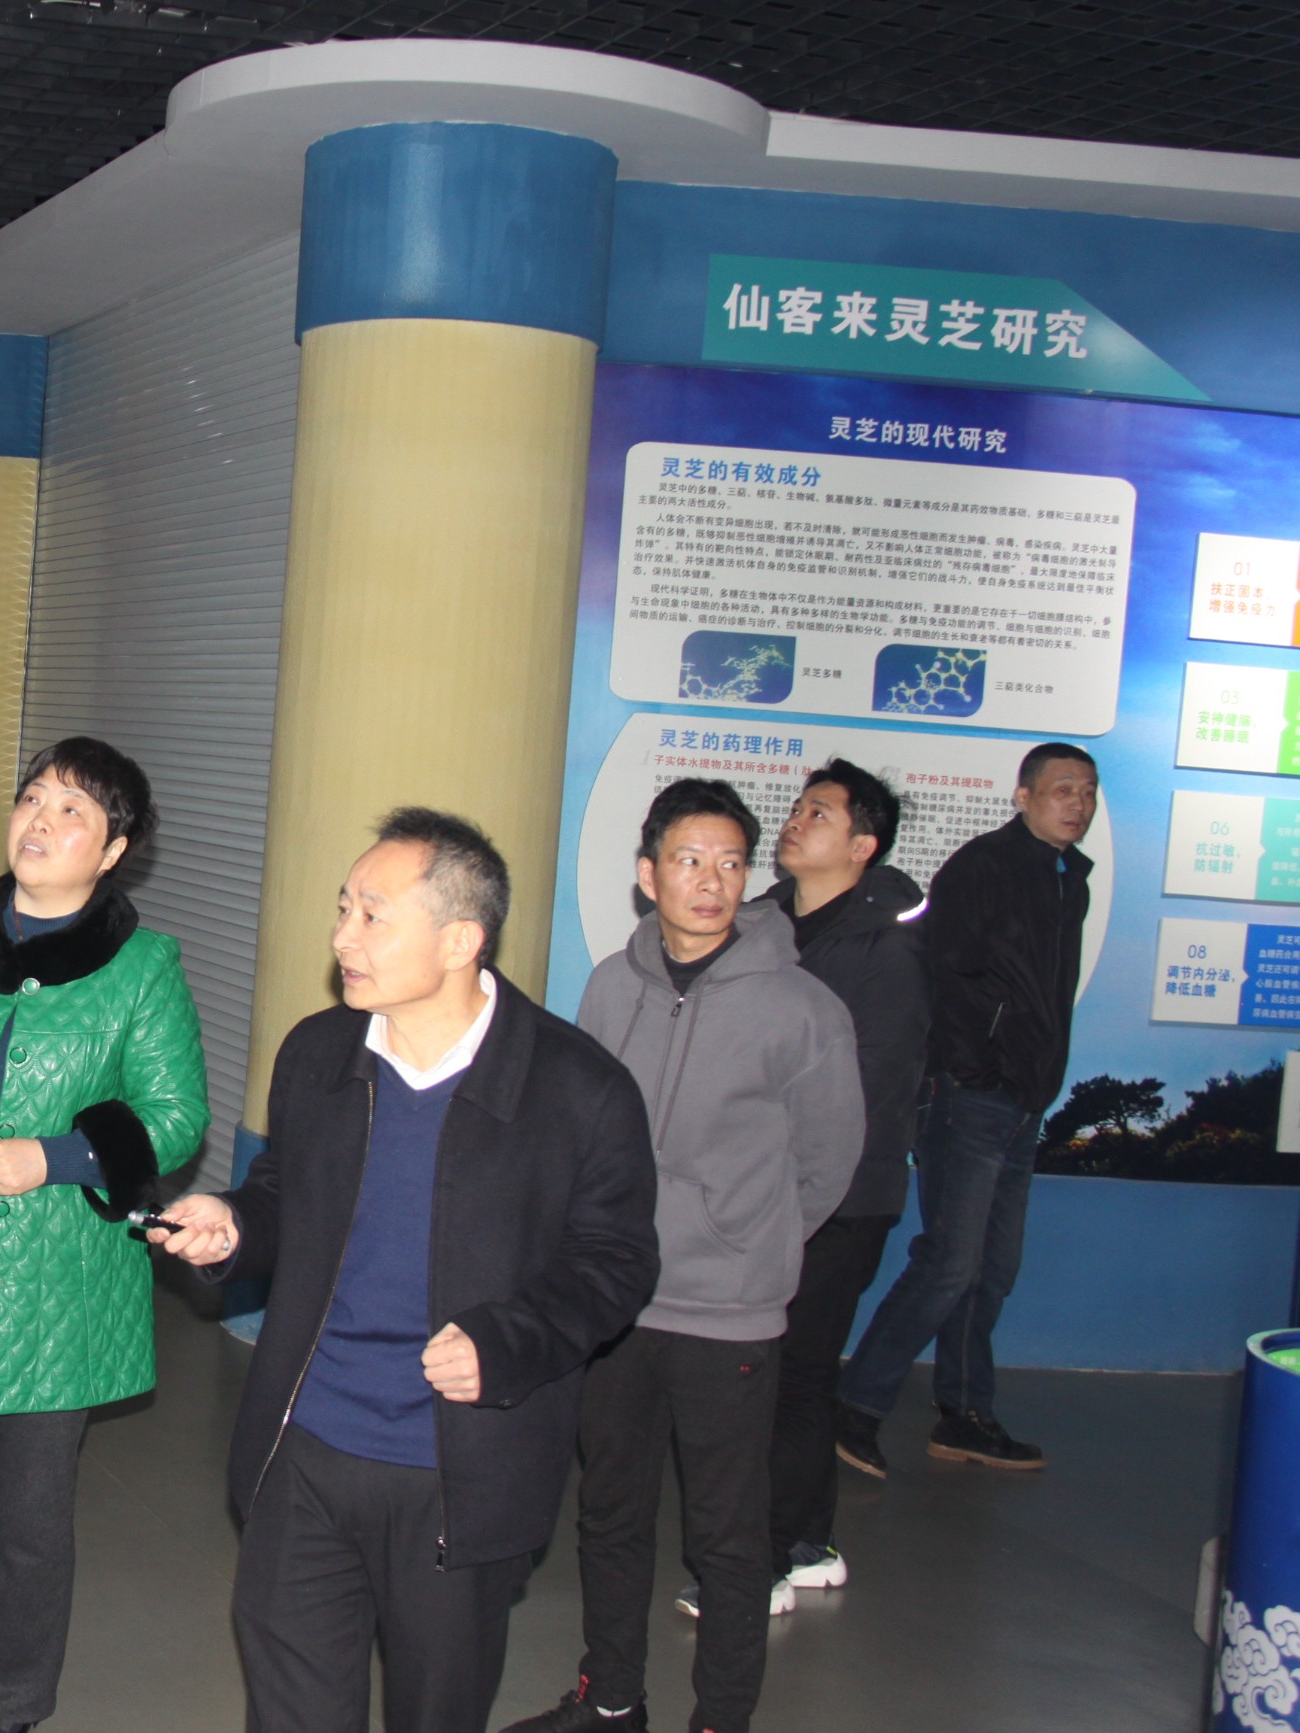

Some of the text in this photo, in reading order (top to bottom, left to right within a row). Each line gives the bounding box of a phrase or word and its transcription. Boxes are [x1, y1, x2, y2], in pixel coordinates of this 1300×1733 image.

[723, 283, 1089, 359] 仙客来灵芝研究
[829, 416, 1008, 454] 灵芝的现代研究
[660, 456, 822, 488] 灵芝的有效成分
[638, 494, 732, 512] 主要的两大活性成分。
[632, 566, 717, 582] 态，保持肌体健康。
[1233, 561, 1251, 577] 01
[1208, 598, 1276, 617] 增强免疫力
[801, 667, 842, 680] 灵芝多糖
[994, 680, 1055, 695] 三萜类化合物
[1220, 690, 1240, 704] 03
[658, 727, 804, 757] 灵芝的药理作用
[1195, 727, 1250, 744] 改善睡眠
[653, 754, 825, 777] 子实体水提物及其所含多糖（肽
[906, 773, 995, 790] 孢子粉及其提取物
[1210, 820, 1230, 836] 06
[896, 857, 945, 868] 孢子粉中提
[1194, 858, 1234, 874] 防辐射
[1187, 943, 1207, 959] 08
[1166, 964, 1236, 984] 调节内分泌，
[1164, 981, 1217, 997] 降低血糖
